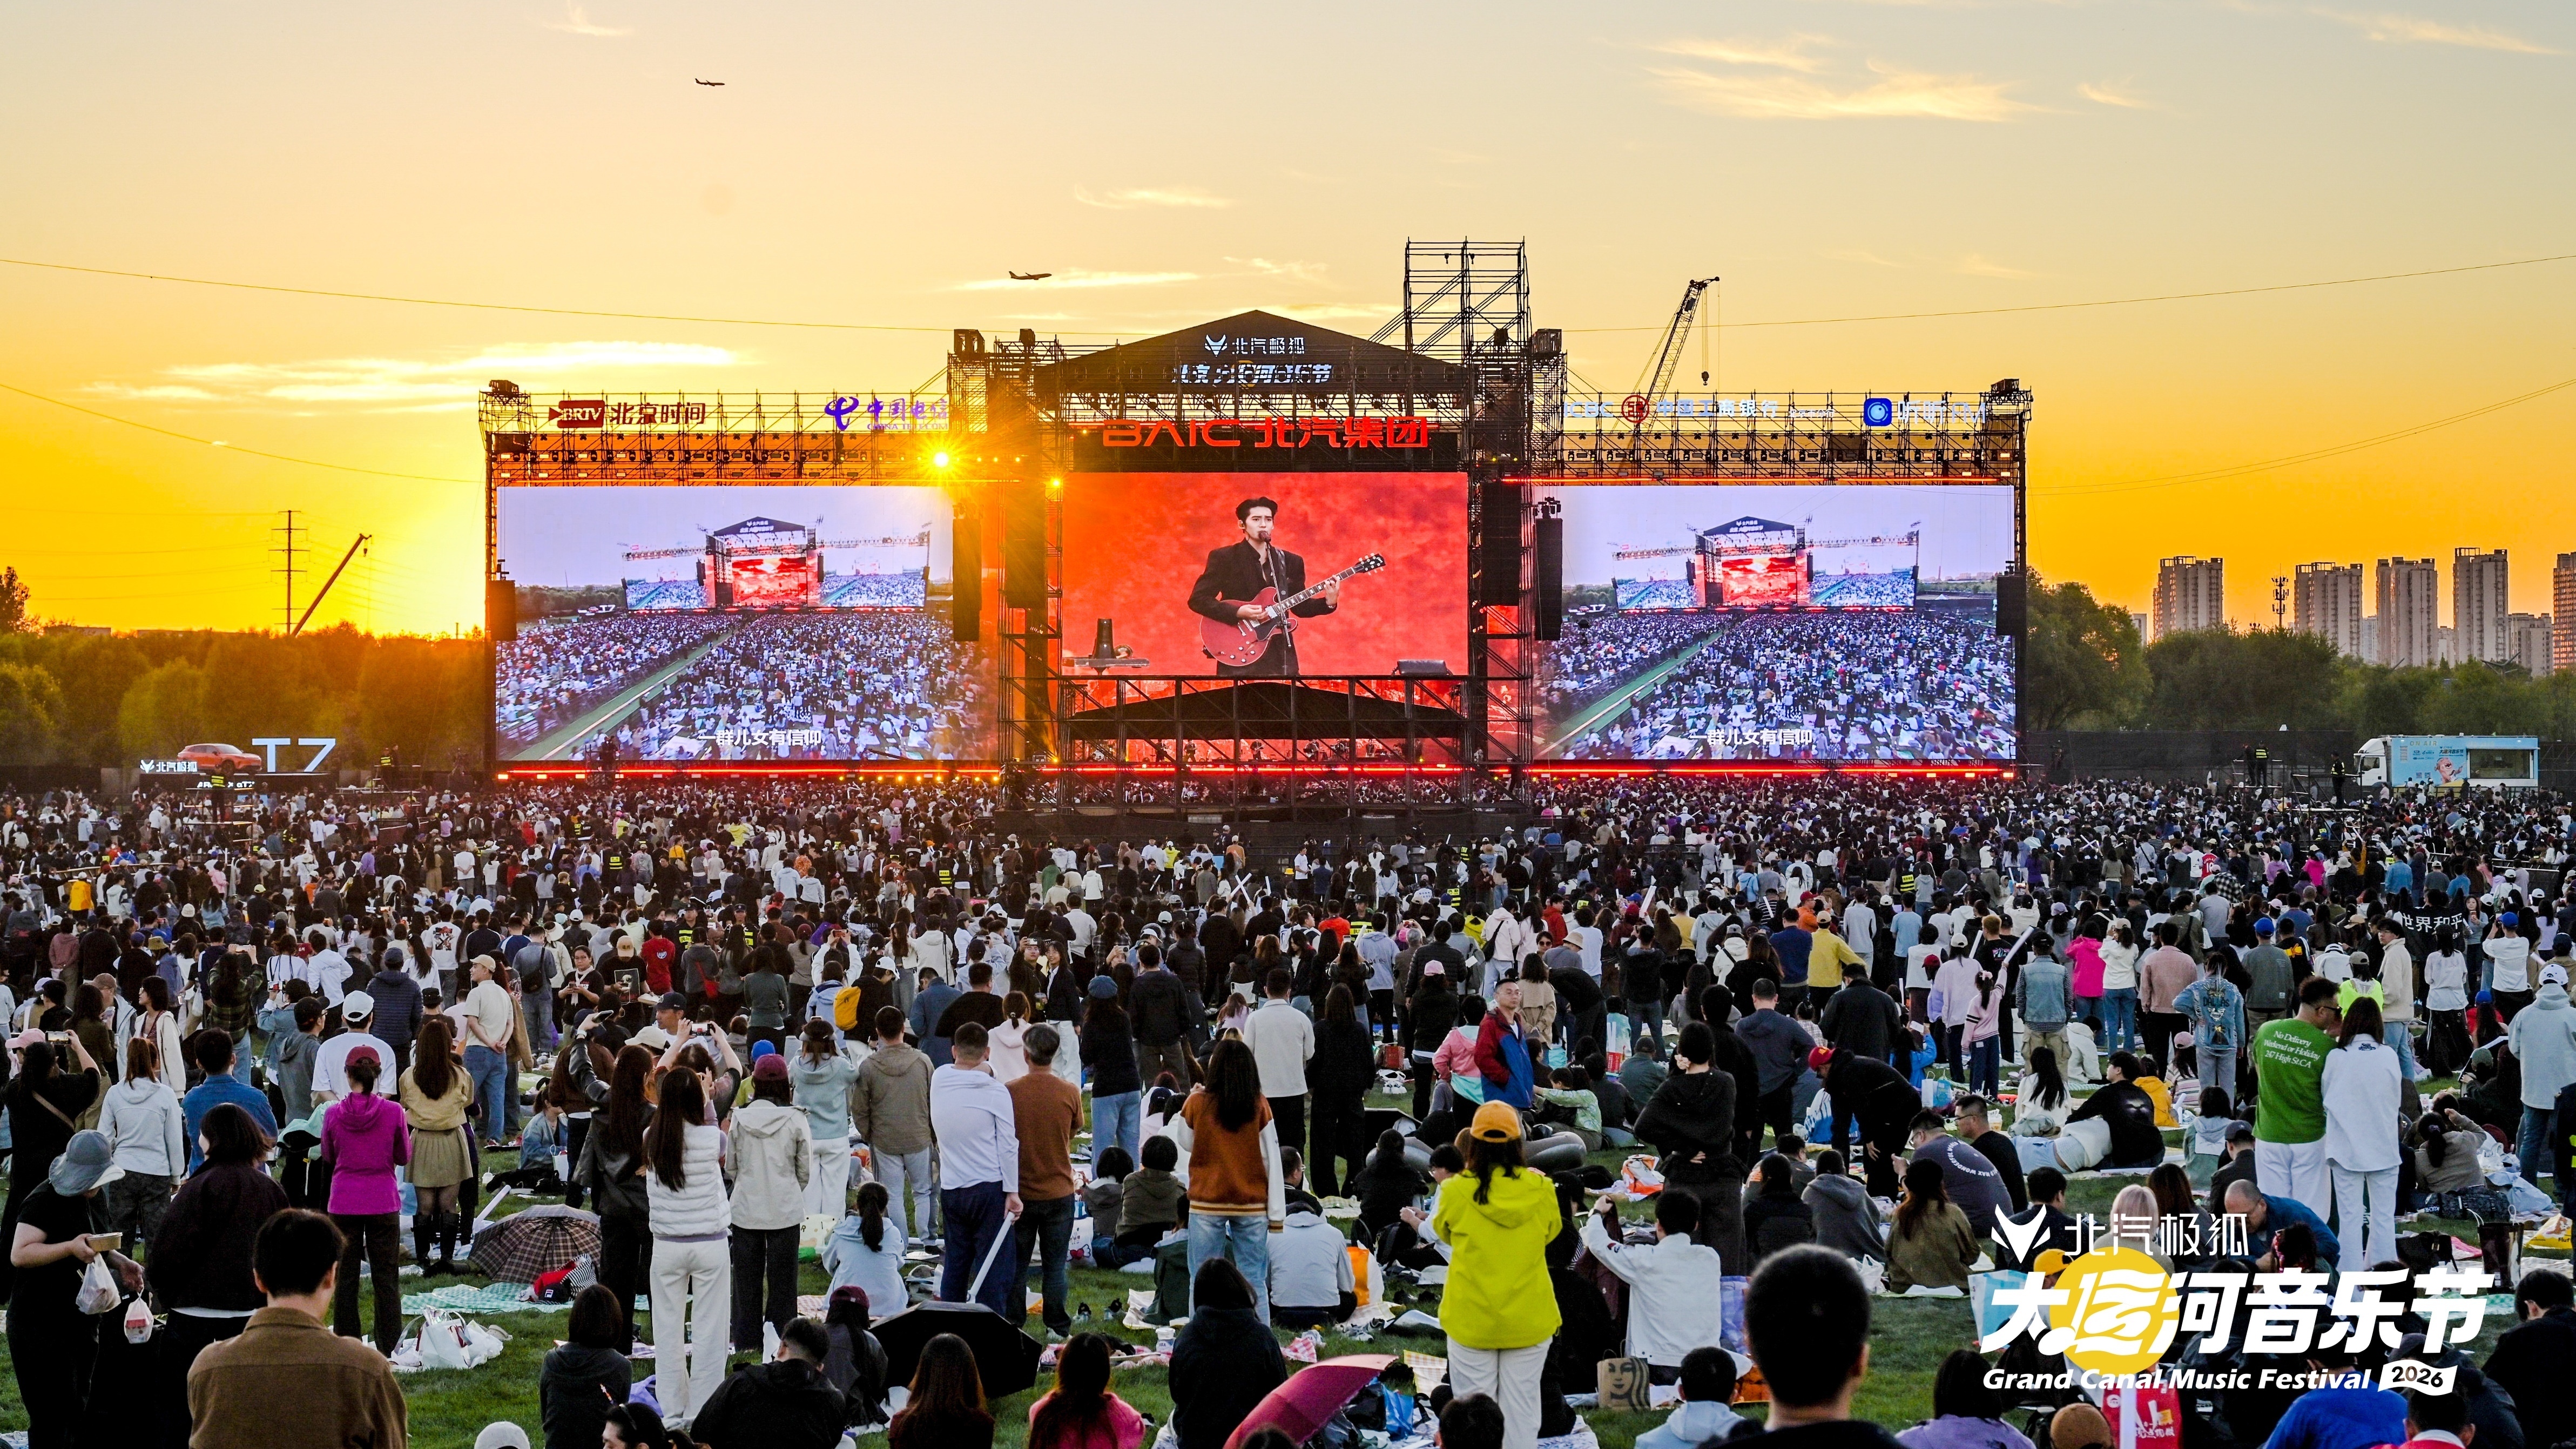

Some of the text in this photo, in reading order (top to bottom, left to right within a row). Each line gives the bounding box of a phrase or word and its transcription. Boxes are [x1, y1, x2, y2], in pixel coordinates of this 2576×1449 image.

[1232, 337, 1305, 354] 北汽极狐
[562, 407, 602, 421] BRTV
[610, 402, 706, 424] 北京时间
[867, 397, 948, 423] 中国电信
[1563, 401, 1614, 417] ICBC
[1656, 399, 1778, 417] 中国工商银行
[1103, 419, 1240, 447] BAIC
[1255, 416, 1428, 448] 北汽集团
[698, 729, 822, 746] 一群儿女有信仰
[1689, 728, 1813, 746] 一群儿女有信仰
[252, 738, 336, 773] T7
[156, 761, 198, 773] 北汽极狐
[2402, 913, 2463, 933] 世界和平
[2274, 1030, 2312, 1048] No Delivery
[2275, 1053, 2291, 1063] High
[2295, 1047, 2321, 1061] Holiday
[1947, 1152, 1977, 1175] WONDERFUL
